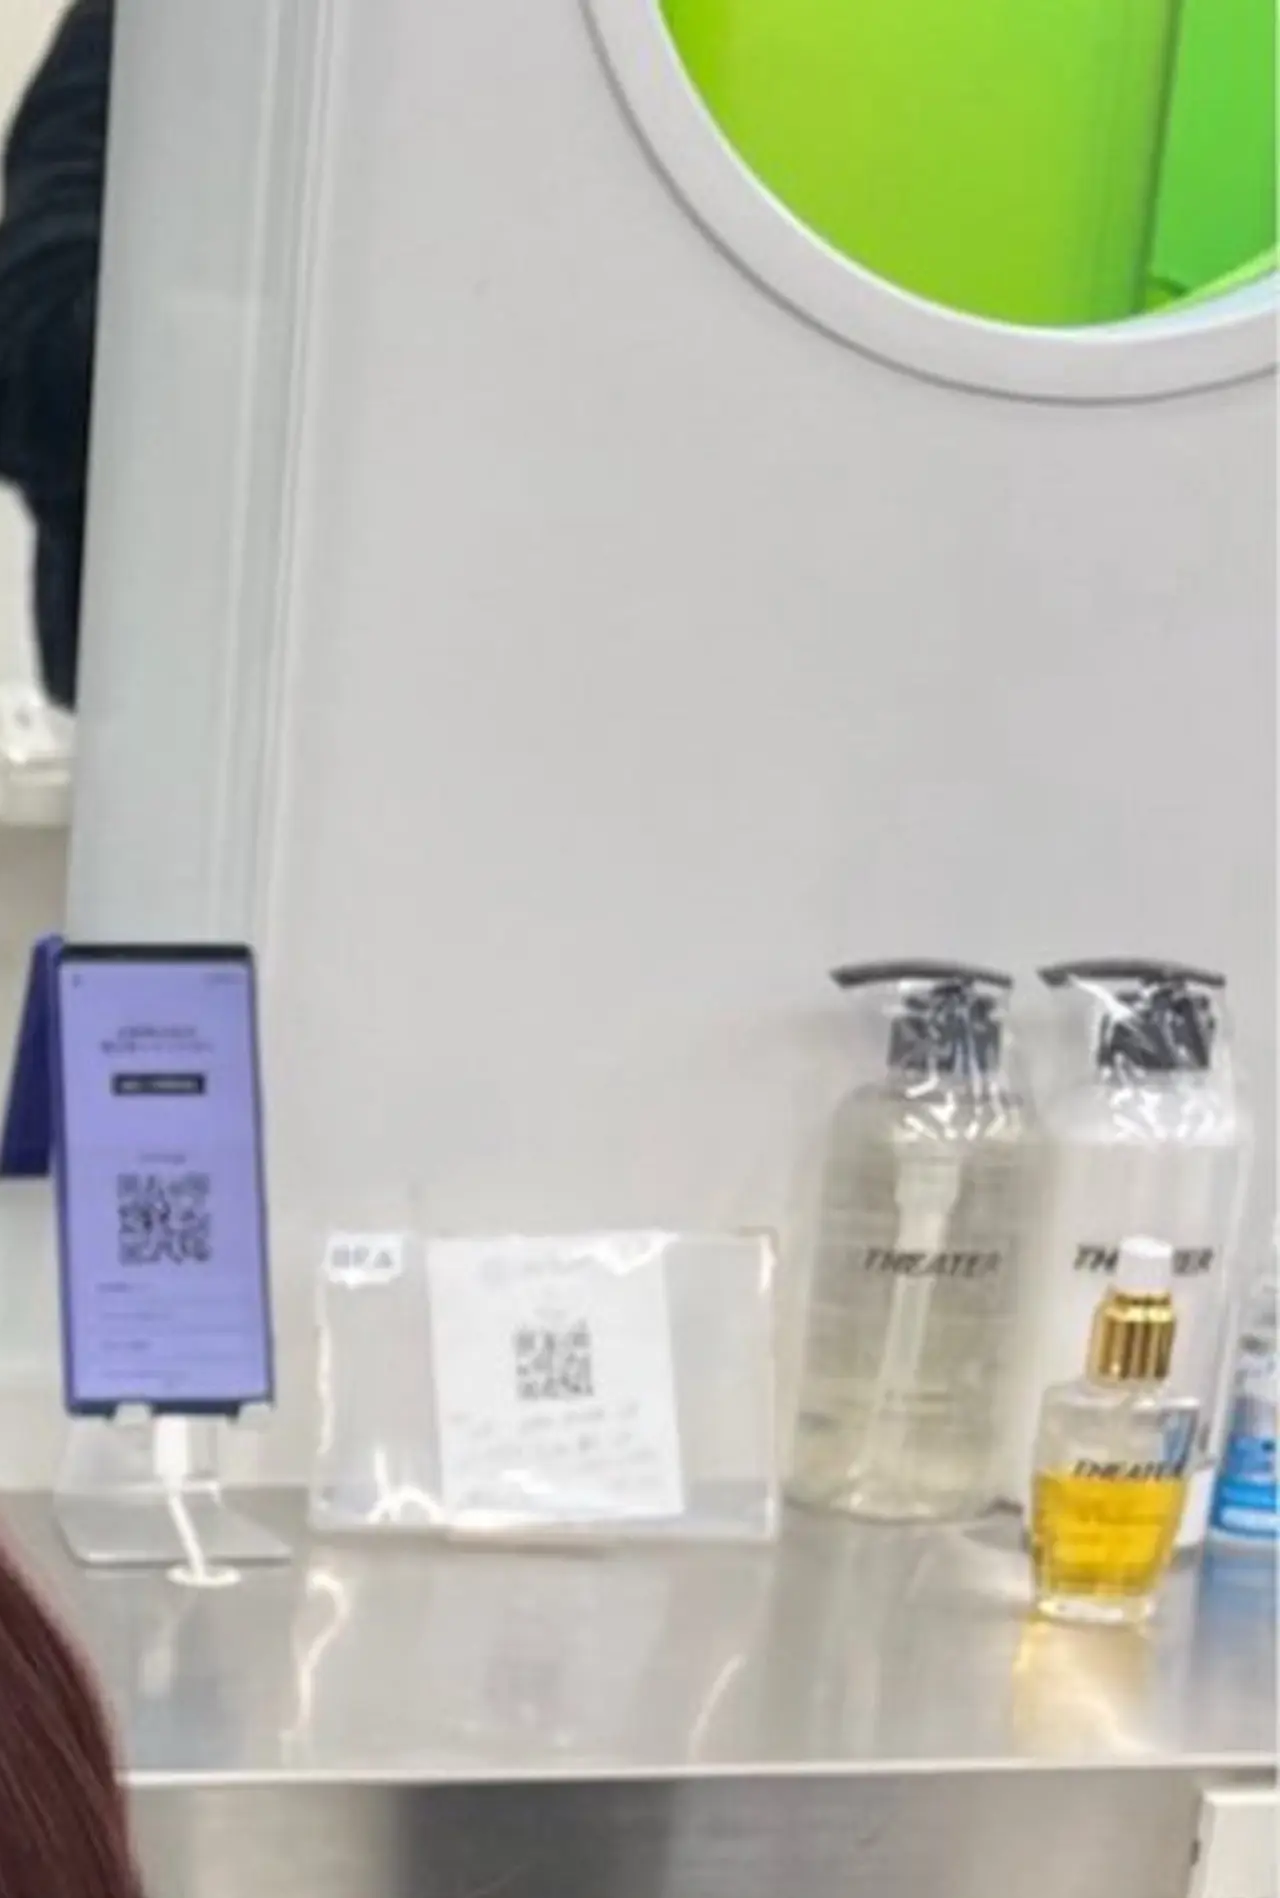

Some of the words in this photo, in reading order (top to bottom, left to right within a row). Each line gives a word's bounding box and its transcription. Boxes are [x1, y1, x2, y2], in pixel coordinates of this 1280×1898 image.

[863, 1247, 1003, 1277] THEATER
[1073, 1245, 1214, 1276] THER
[1072, 1460, 1185, 1482] THEATER
